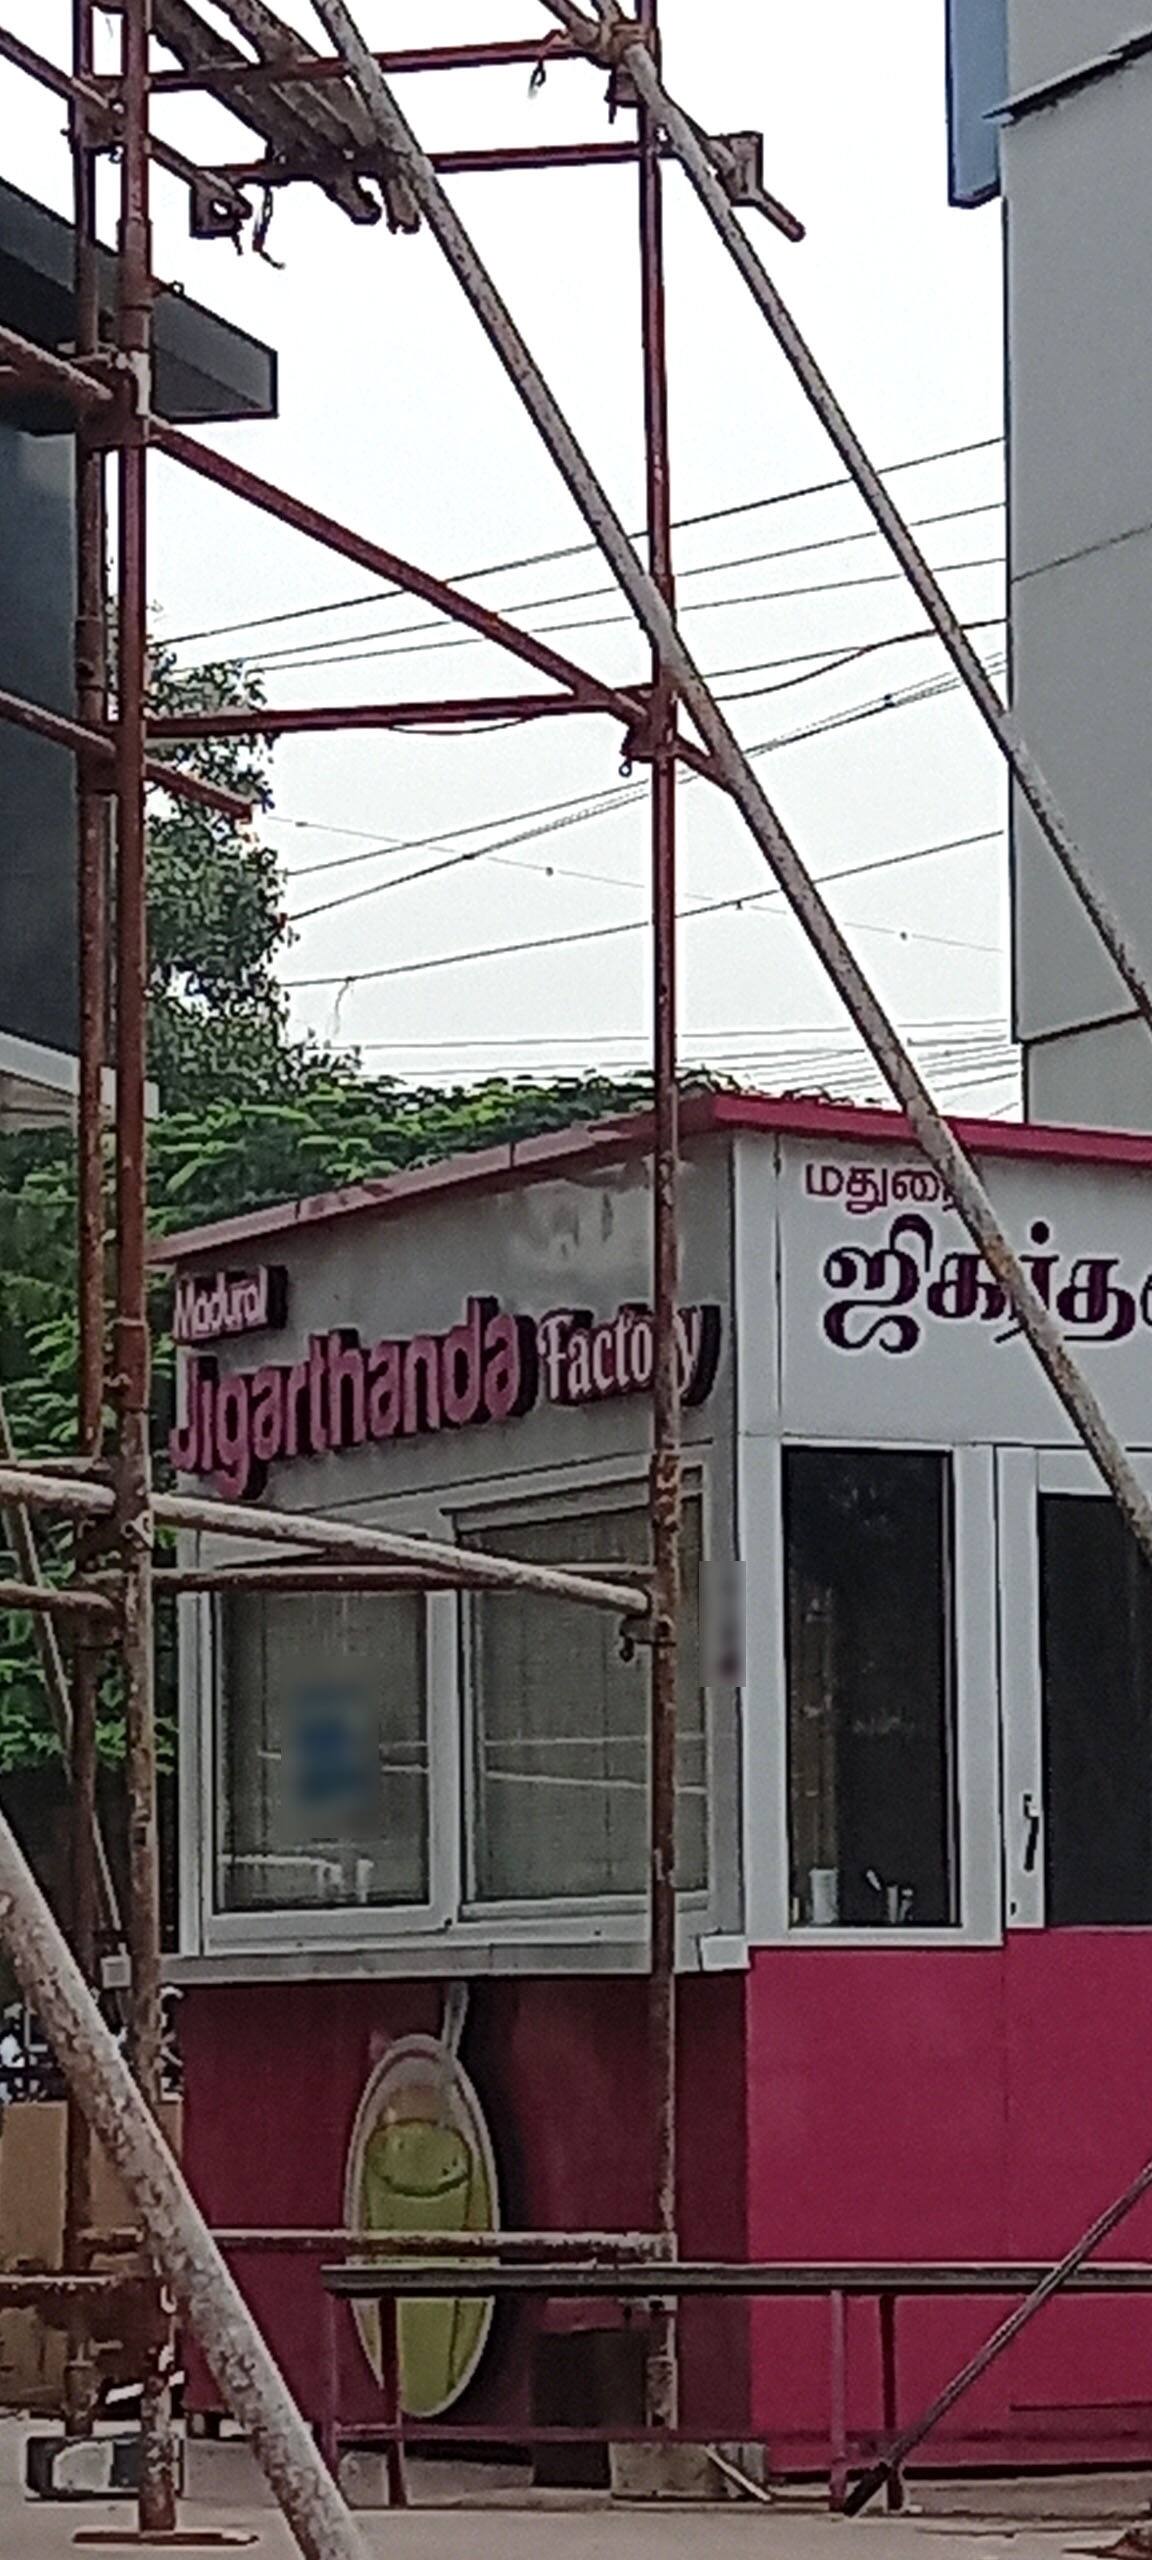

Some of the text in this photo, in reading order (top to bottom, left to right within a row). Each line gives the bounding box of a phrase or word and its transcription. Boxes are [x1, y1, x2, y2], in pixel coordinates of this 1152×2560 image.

[172, 1264, 269, 1340] Madurai
[823, 1212, 1152, 1355] ஜிகர்த
[168, 1297, 704, 1500] Jigarthanda Factoy
